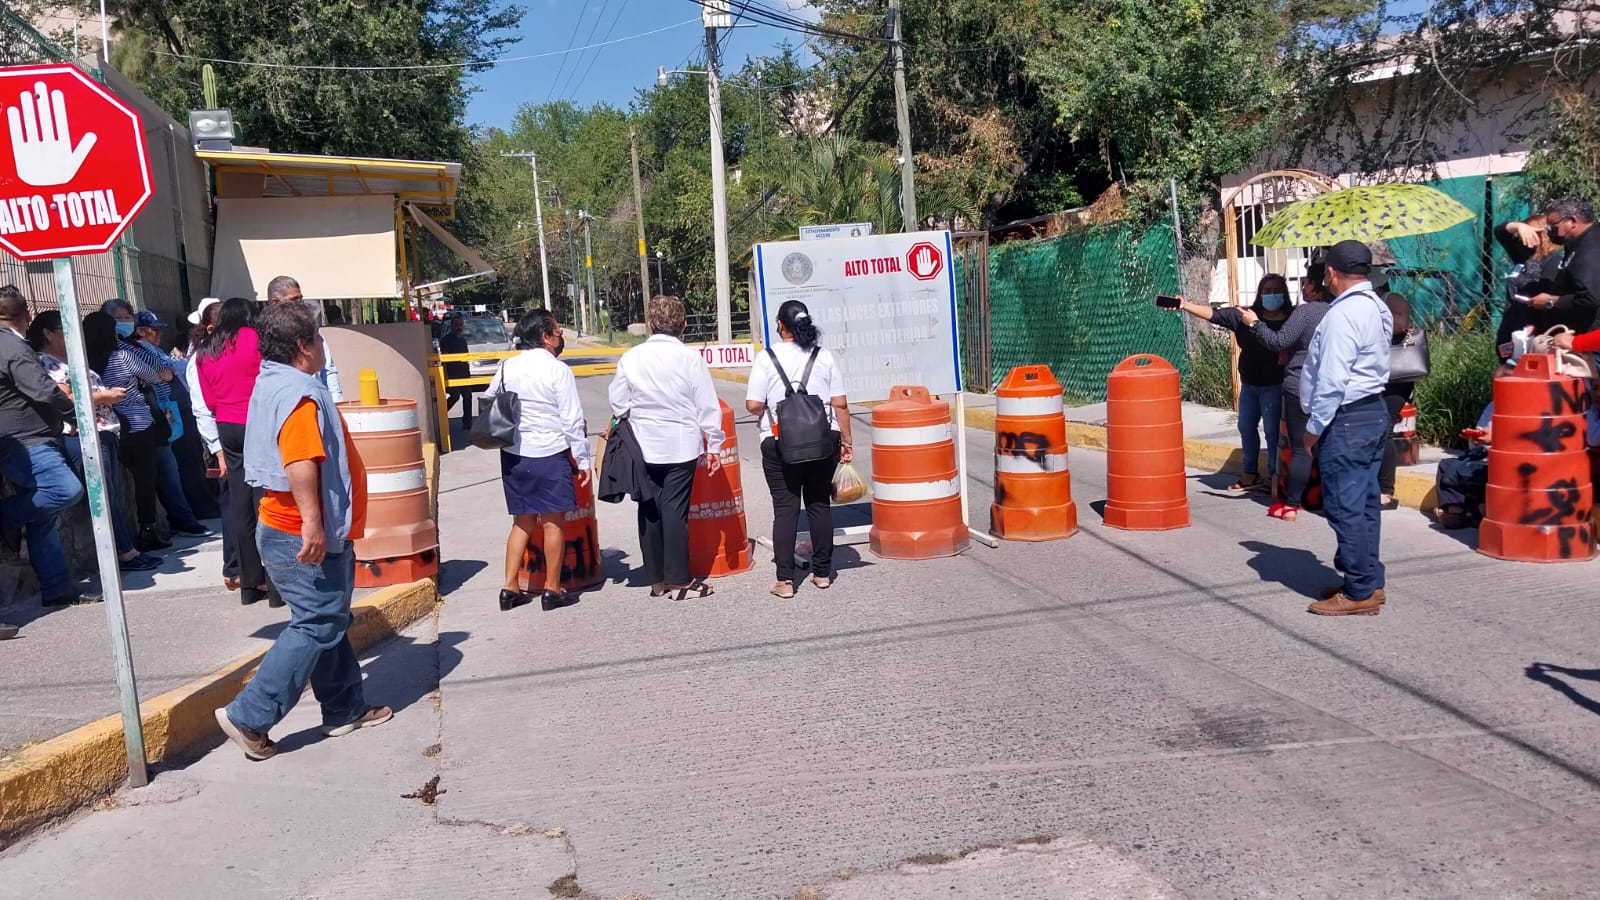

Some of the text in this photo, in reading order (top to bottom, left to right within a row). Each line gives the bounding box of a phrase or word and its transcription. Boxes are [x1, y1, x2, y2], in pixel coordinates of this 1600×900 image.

[0, 189, 122, 235] ALTO TOTAL
[845, 256, 902, 277] ALTO TOTAL
[844, 303, 876, 321] LUCES
[718, 347, 752, 364] TOTAL
